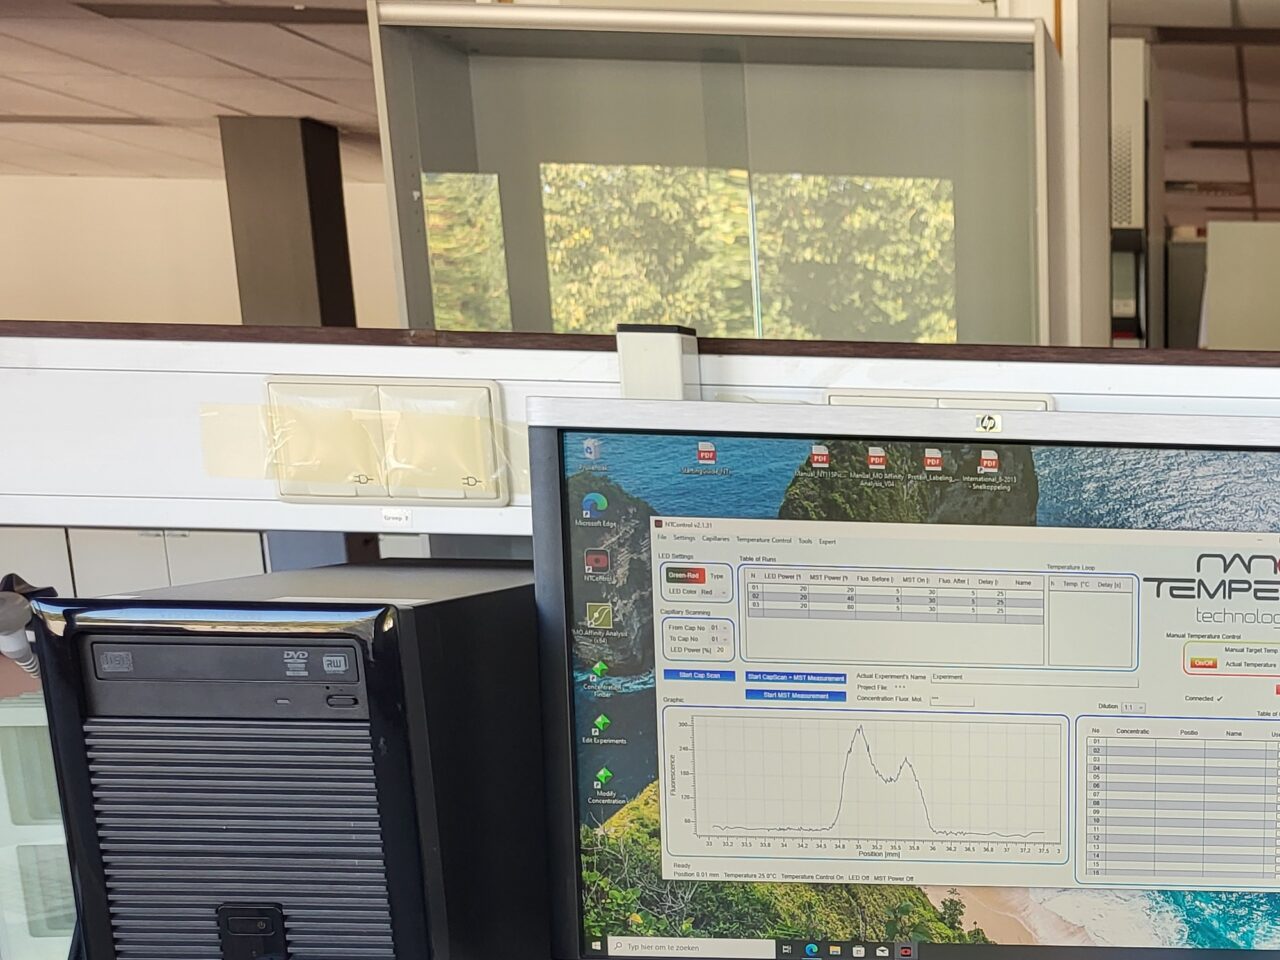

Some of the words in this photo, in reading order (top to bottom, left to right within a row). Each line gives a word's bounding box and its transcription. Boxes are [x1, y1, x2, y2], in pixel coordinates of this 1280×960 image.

[628, 943, 639, 952] Typ
[640, 943, 653, 951] hier
[676, 944, 699, 952] zoeken
